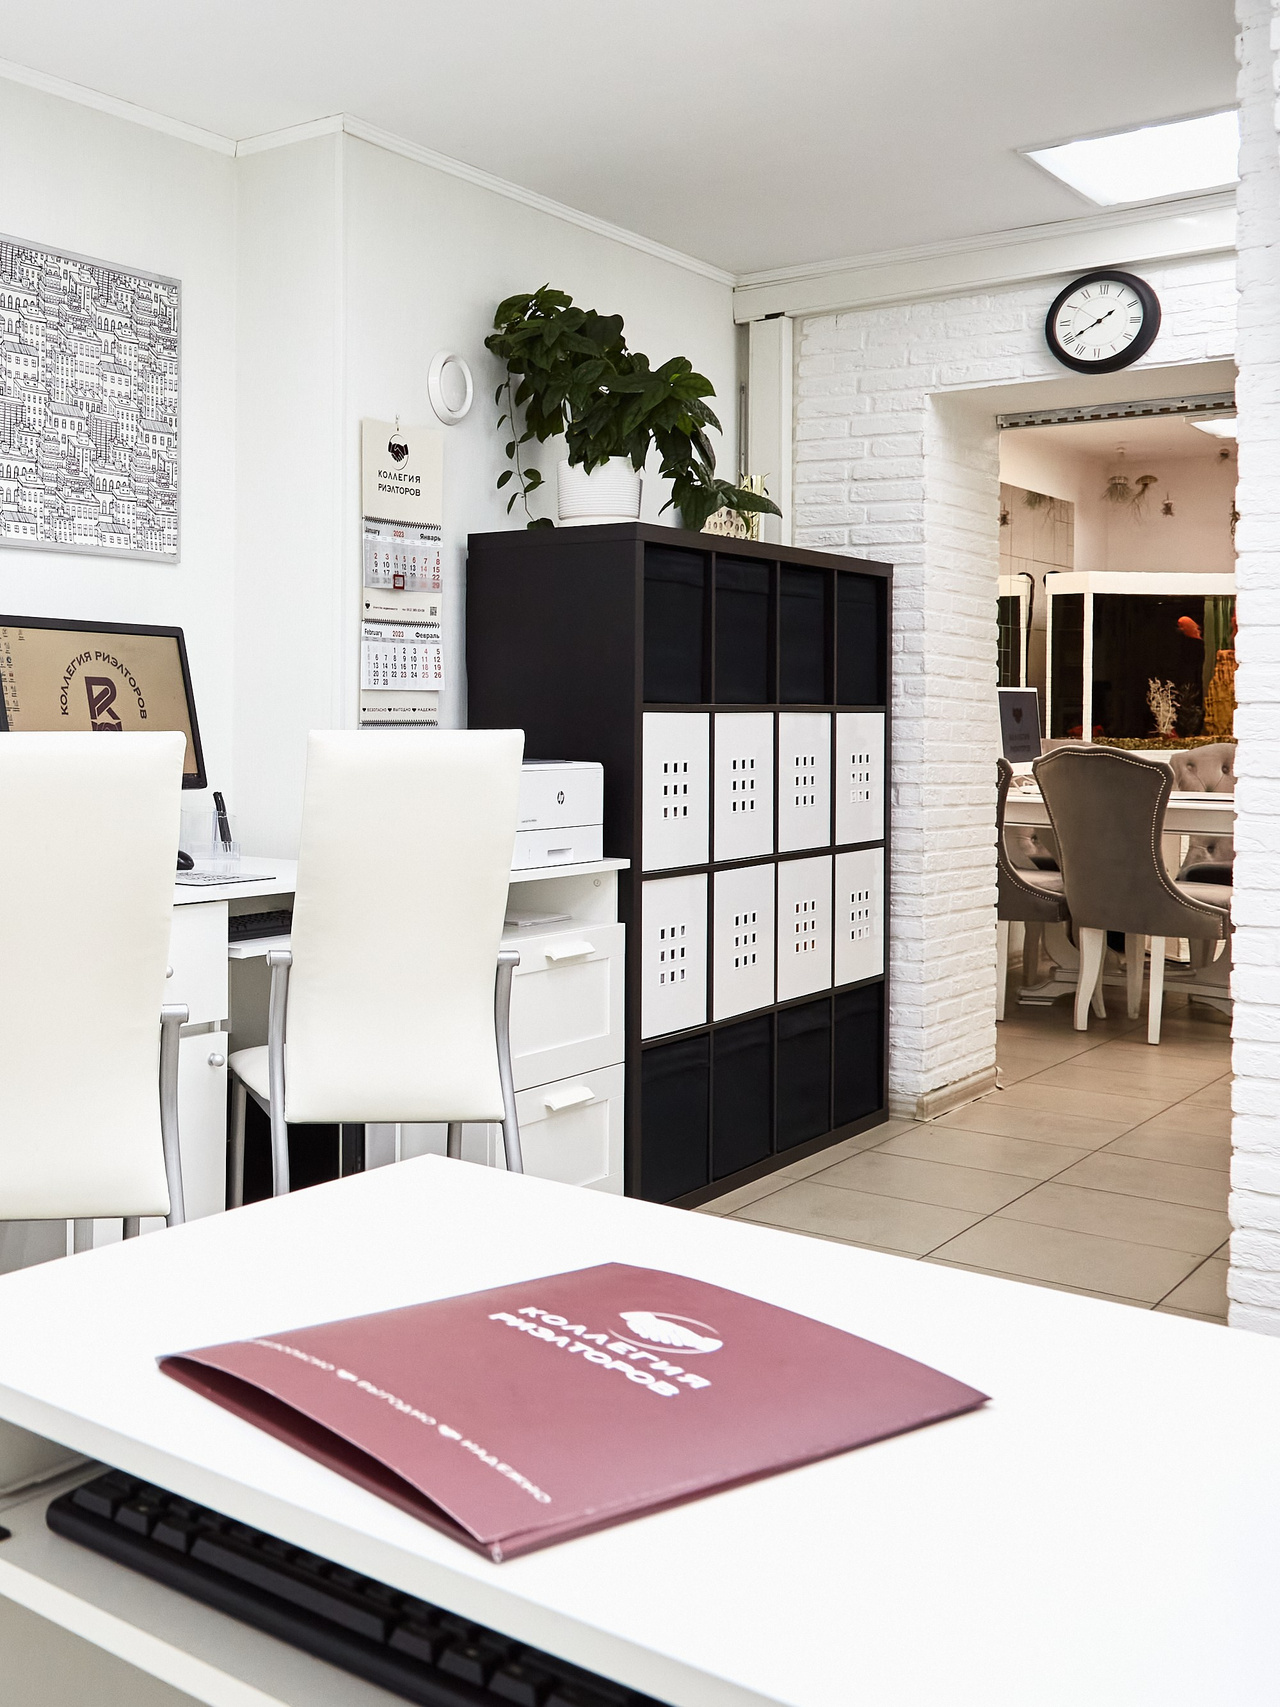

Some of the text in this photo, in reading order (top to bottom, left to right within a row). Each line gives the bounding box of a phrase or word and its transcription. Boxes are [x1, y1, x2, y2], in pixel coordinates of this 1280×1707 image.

[378, 470, 420, 483] КОЛЛЕГИЯ
[378, 483, 420, 496] РИЭЛТОРОВ
[365, 527, 380, 536] January
[364, 628, 382, 637] February
[60, 652, 92, 716] КОЛЛЕГИЯ
[94, 651, 147, 719] РИЭЛТОРОВ
[518, 1306, 711, 1389] КОЛЛЕГИЯ
[488, 1312, 680, 1397] РИЭЛТОРОВ
